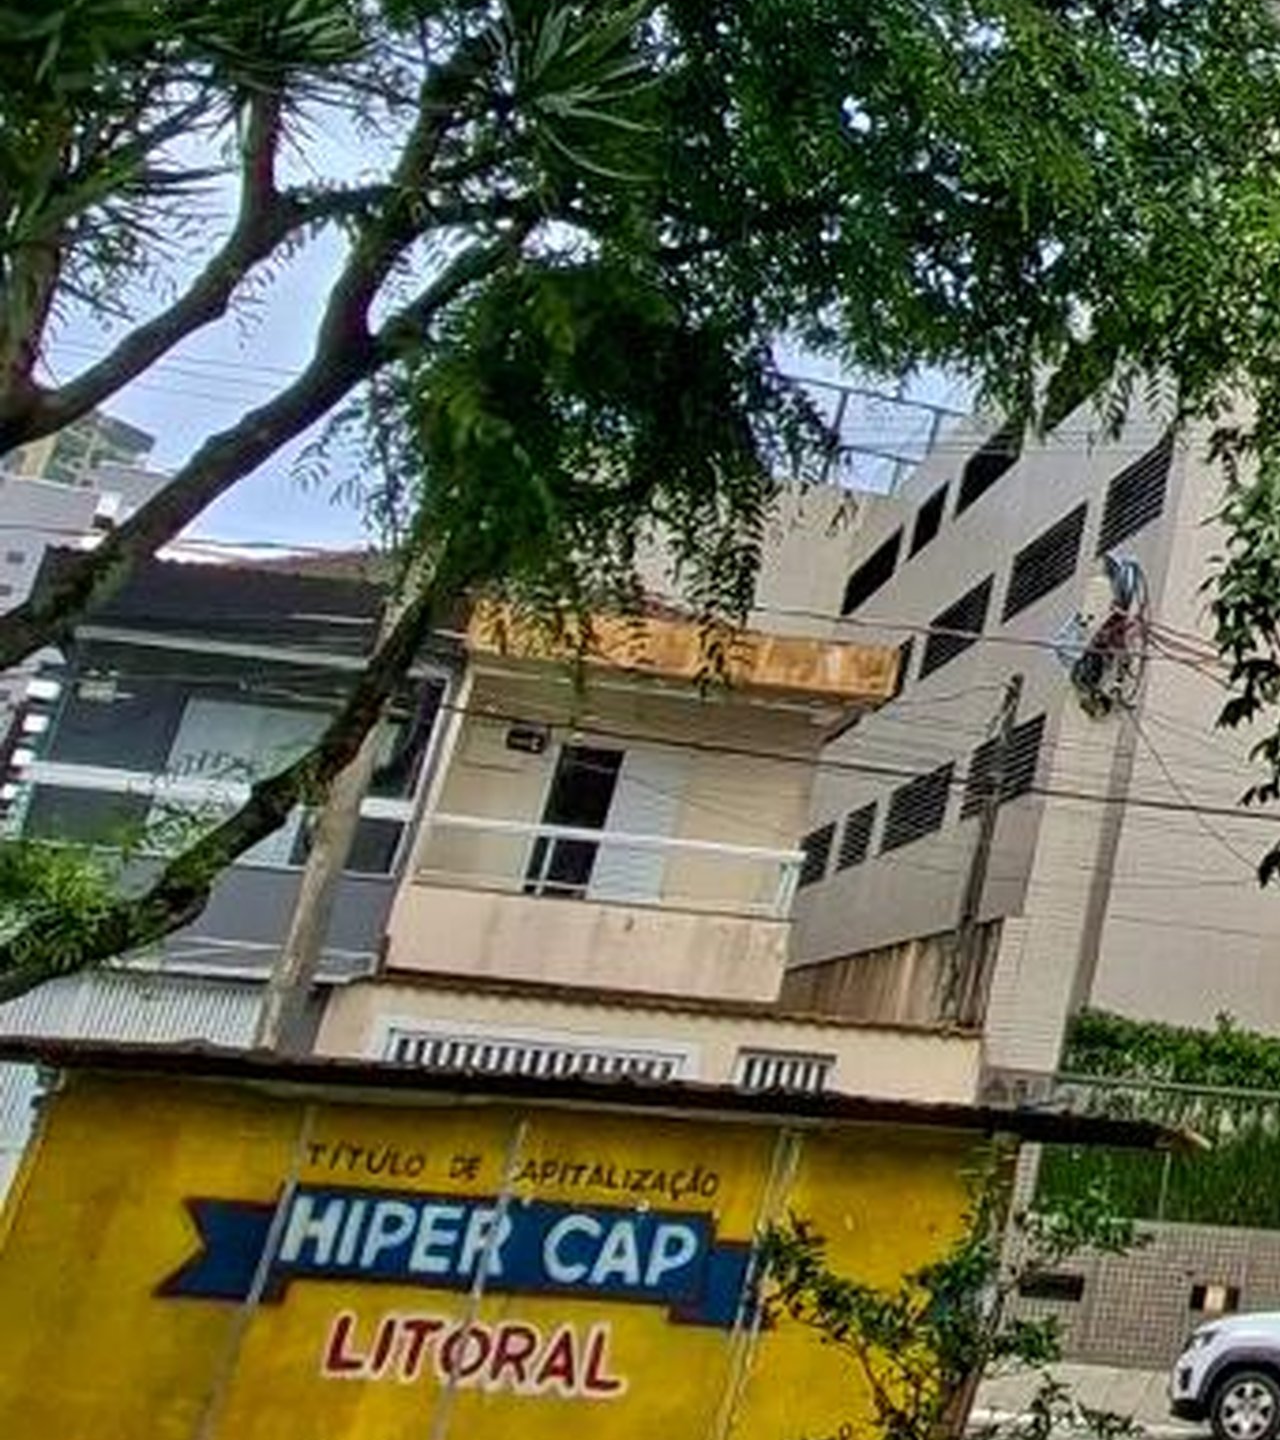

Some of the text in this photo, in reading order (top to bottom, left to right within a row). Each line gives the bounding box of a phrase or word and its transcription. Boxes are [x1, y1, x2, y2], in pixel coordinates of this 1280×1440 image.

[279, 1196, 698, 1285] HIPER CAP
[324, 1313, 626, 1396] LITORAL
